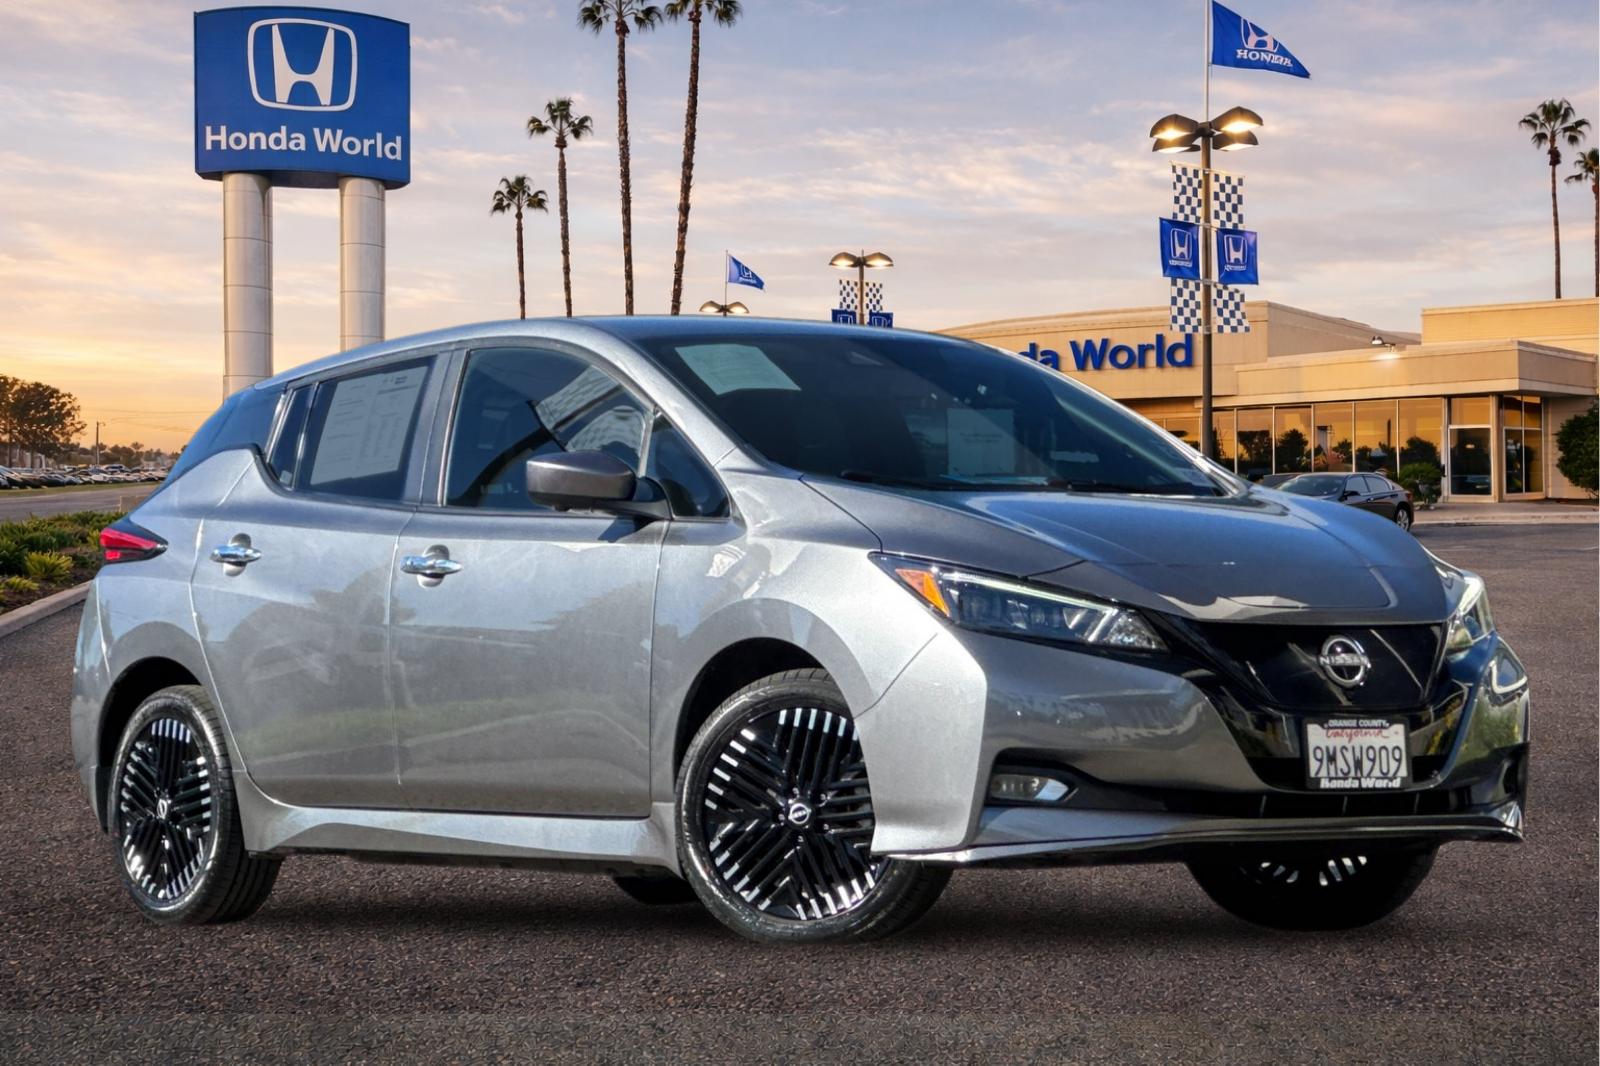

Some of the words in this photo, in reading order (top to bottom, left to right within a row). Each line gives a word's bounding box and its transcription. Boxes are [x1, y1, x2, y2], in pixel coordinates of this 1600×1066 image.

[205, 126, 306, 151] Honda
[312, 127, 402, 161] World
[1069, 333, 1194, 371] World
[1313, 745, 1402, 777] 9MSW909
